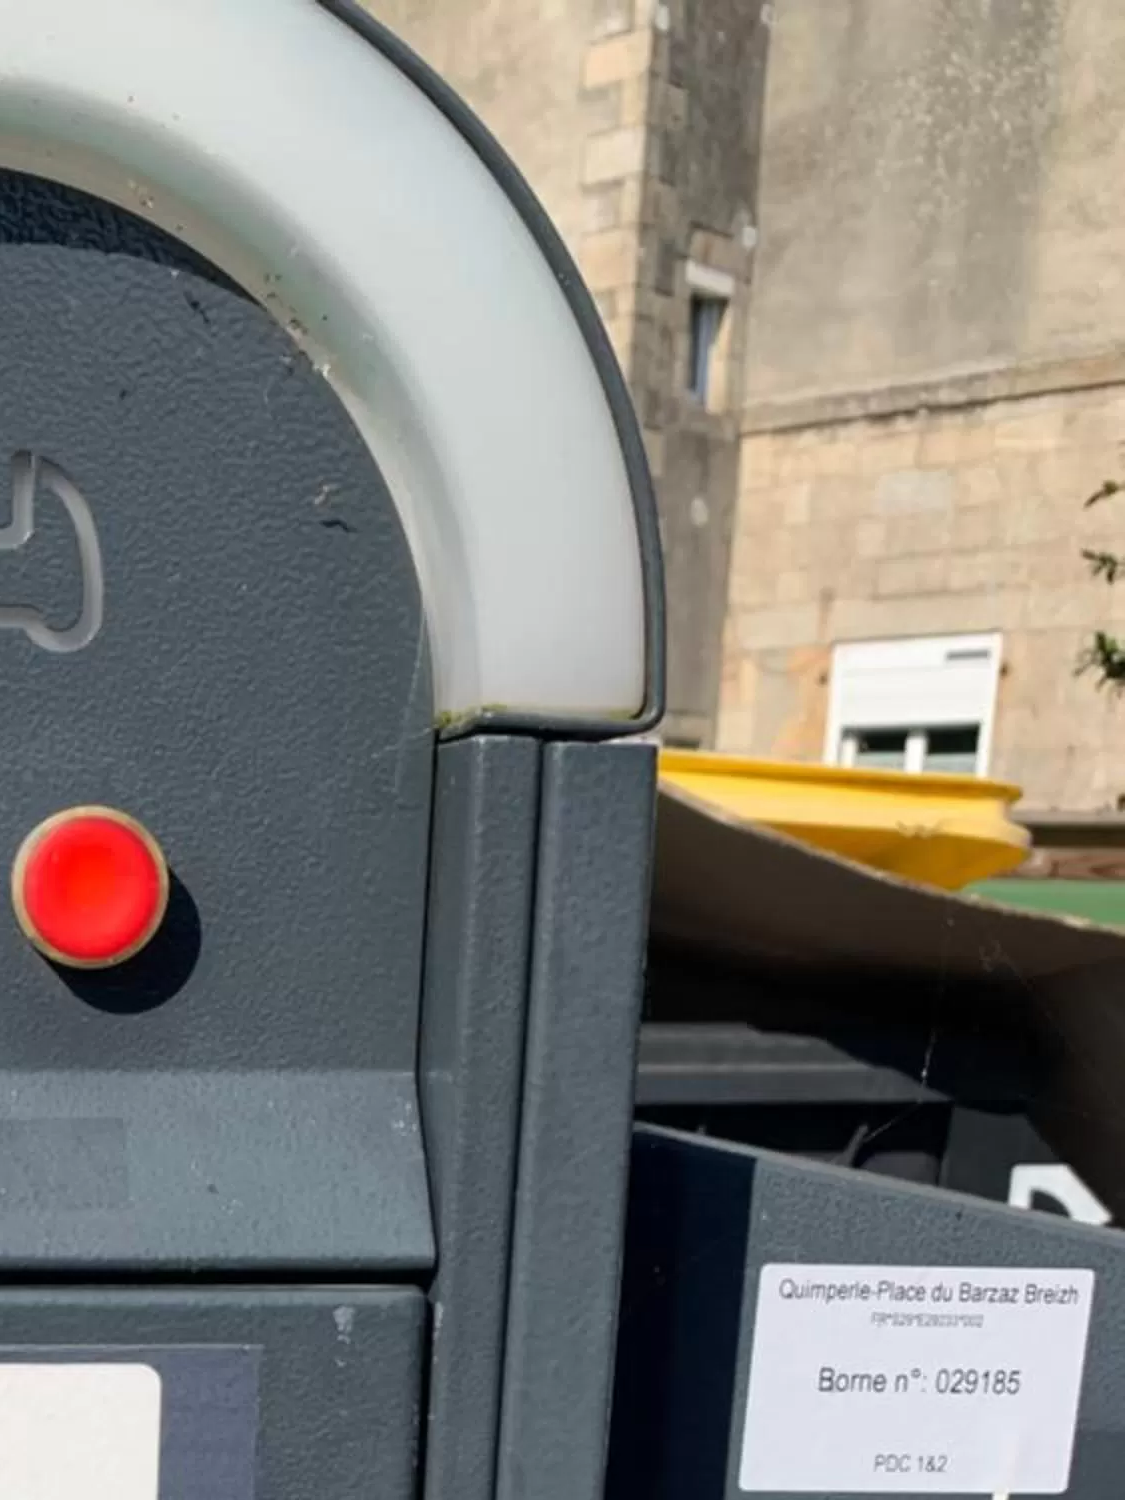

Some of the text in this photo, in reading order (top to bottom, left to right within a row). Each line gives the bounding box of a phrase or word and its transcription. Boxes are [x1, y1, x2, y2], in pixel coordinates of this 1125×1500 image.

[931, 1282, 953, 1303] du
[959, 1282, 1019, 1304] Barzaz
[1024, 1283, 1079, 1305] Breizh
[818, 1367, 886, 1393] Borne
[936, 1369, 1021, 1395] 029185
[874, 1454, 947, 1473] PDC 1&2
